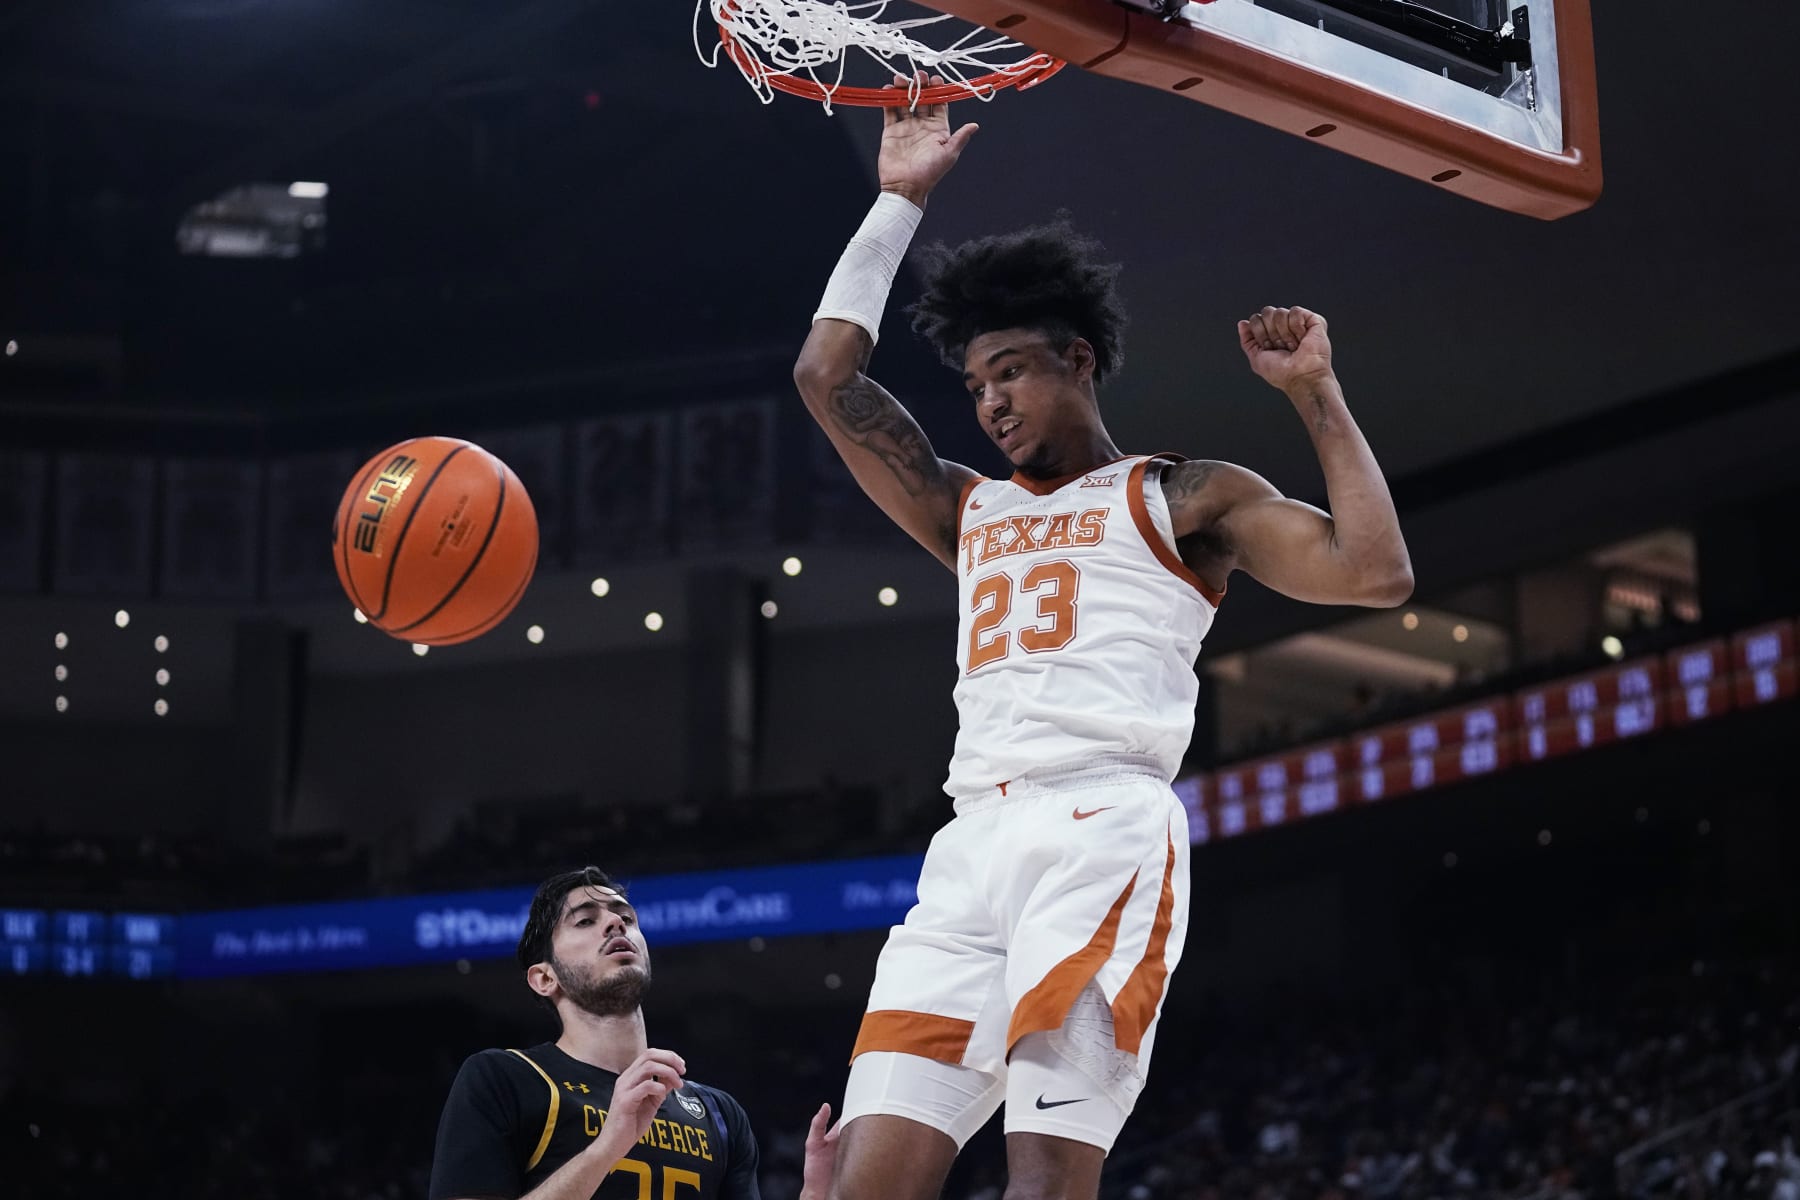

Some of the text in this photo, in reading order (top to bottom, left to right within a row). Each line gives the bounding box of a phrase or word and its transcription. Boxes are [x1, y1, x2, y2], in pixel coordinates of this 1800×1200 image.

[354, 455, 416, 553] ELITE
[961, 507, 1110, 576] TEXAS
[966, 559, 1081, 675] 23
[583, 1104, 713, 1162] CMERCE
